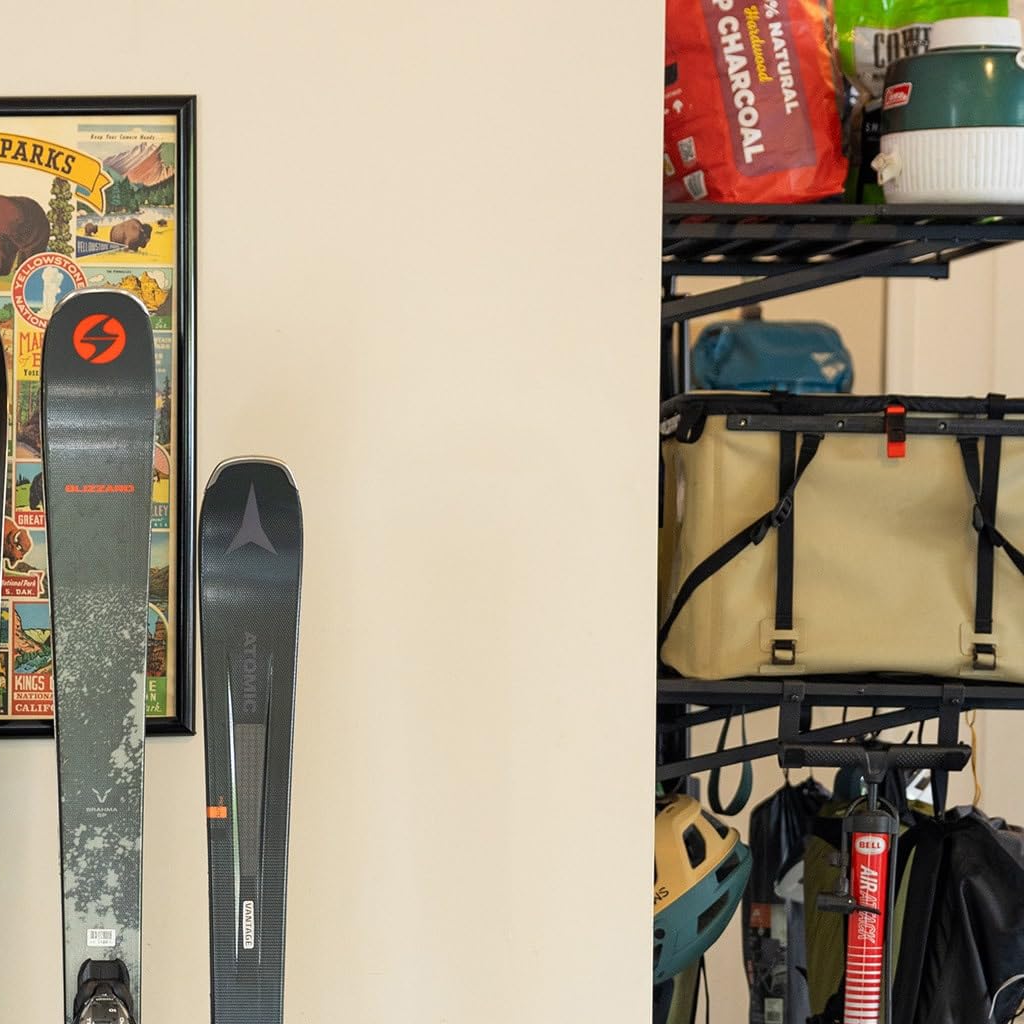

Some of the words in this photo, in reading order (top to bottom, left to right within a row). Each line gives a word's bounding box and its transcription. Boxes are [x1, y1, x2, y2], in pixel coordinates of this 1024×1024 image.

[743, 5, 774, 83] Hardwood
[768, 21, 800, 115] NATURAL
[717, 15, 765, 164] CHARCOAL
[14, 255, 85, 290] YELLOWSTONE
[64, 483, 135, 493] BLIZZARD
[17, 514, 44, 526] GREAT
[15, 675, 46, 691] KINGS
[858, 841, 881, 849] BELL
[859, 864, 879, 894] AIR
[244, 902, 253, 947] VANTAGE
